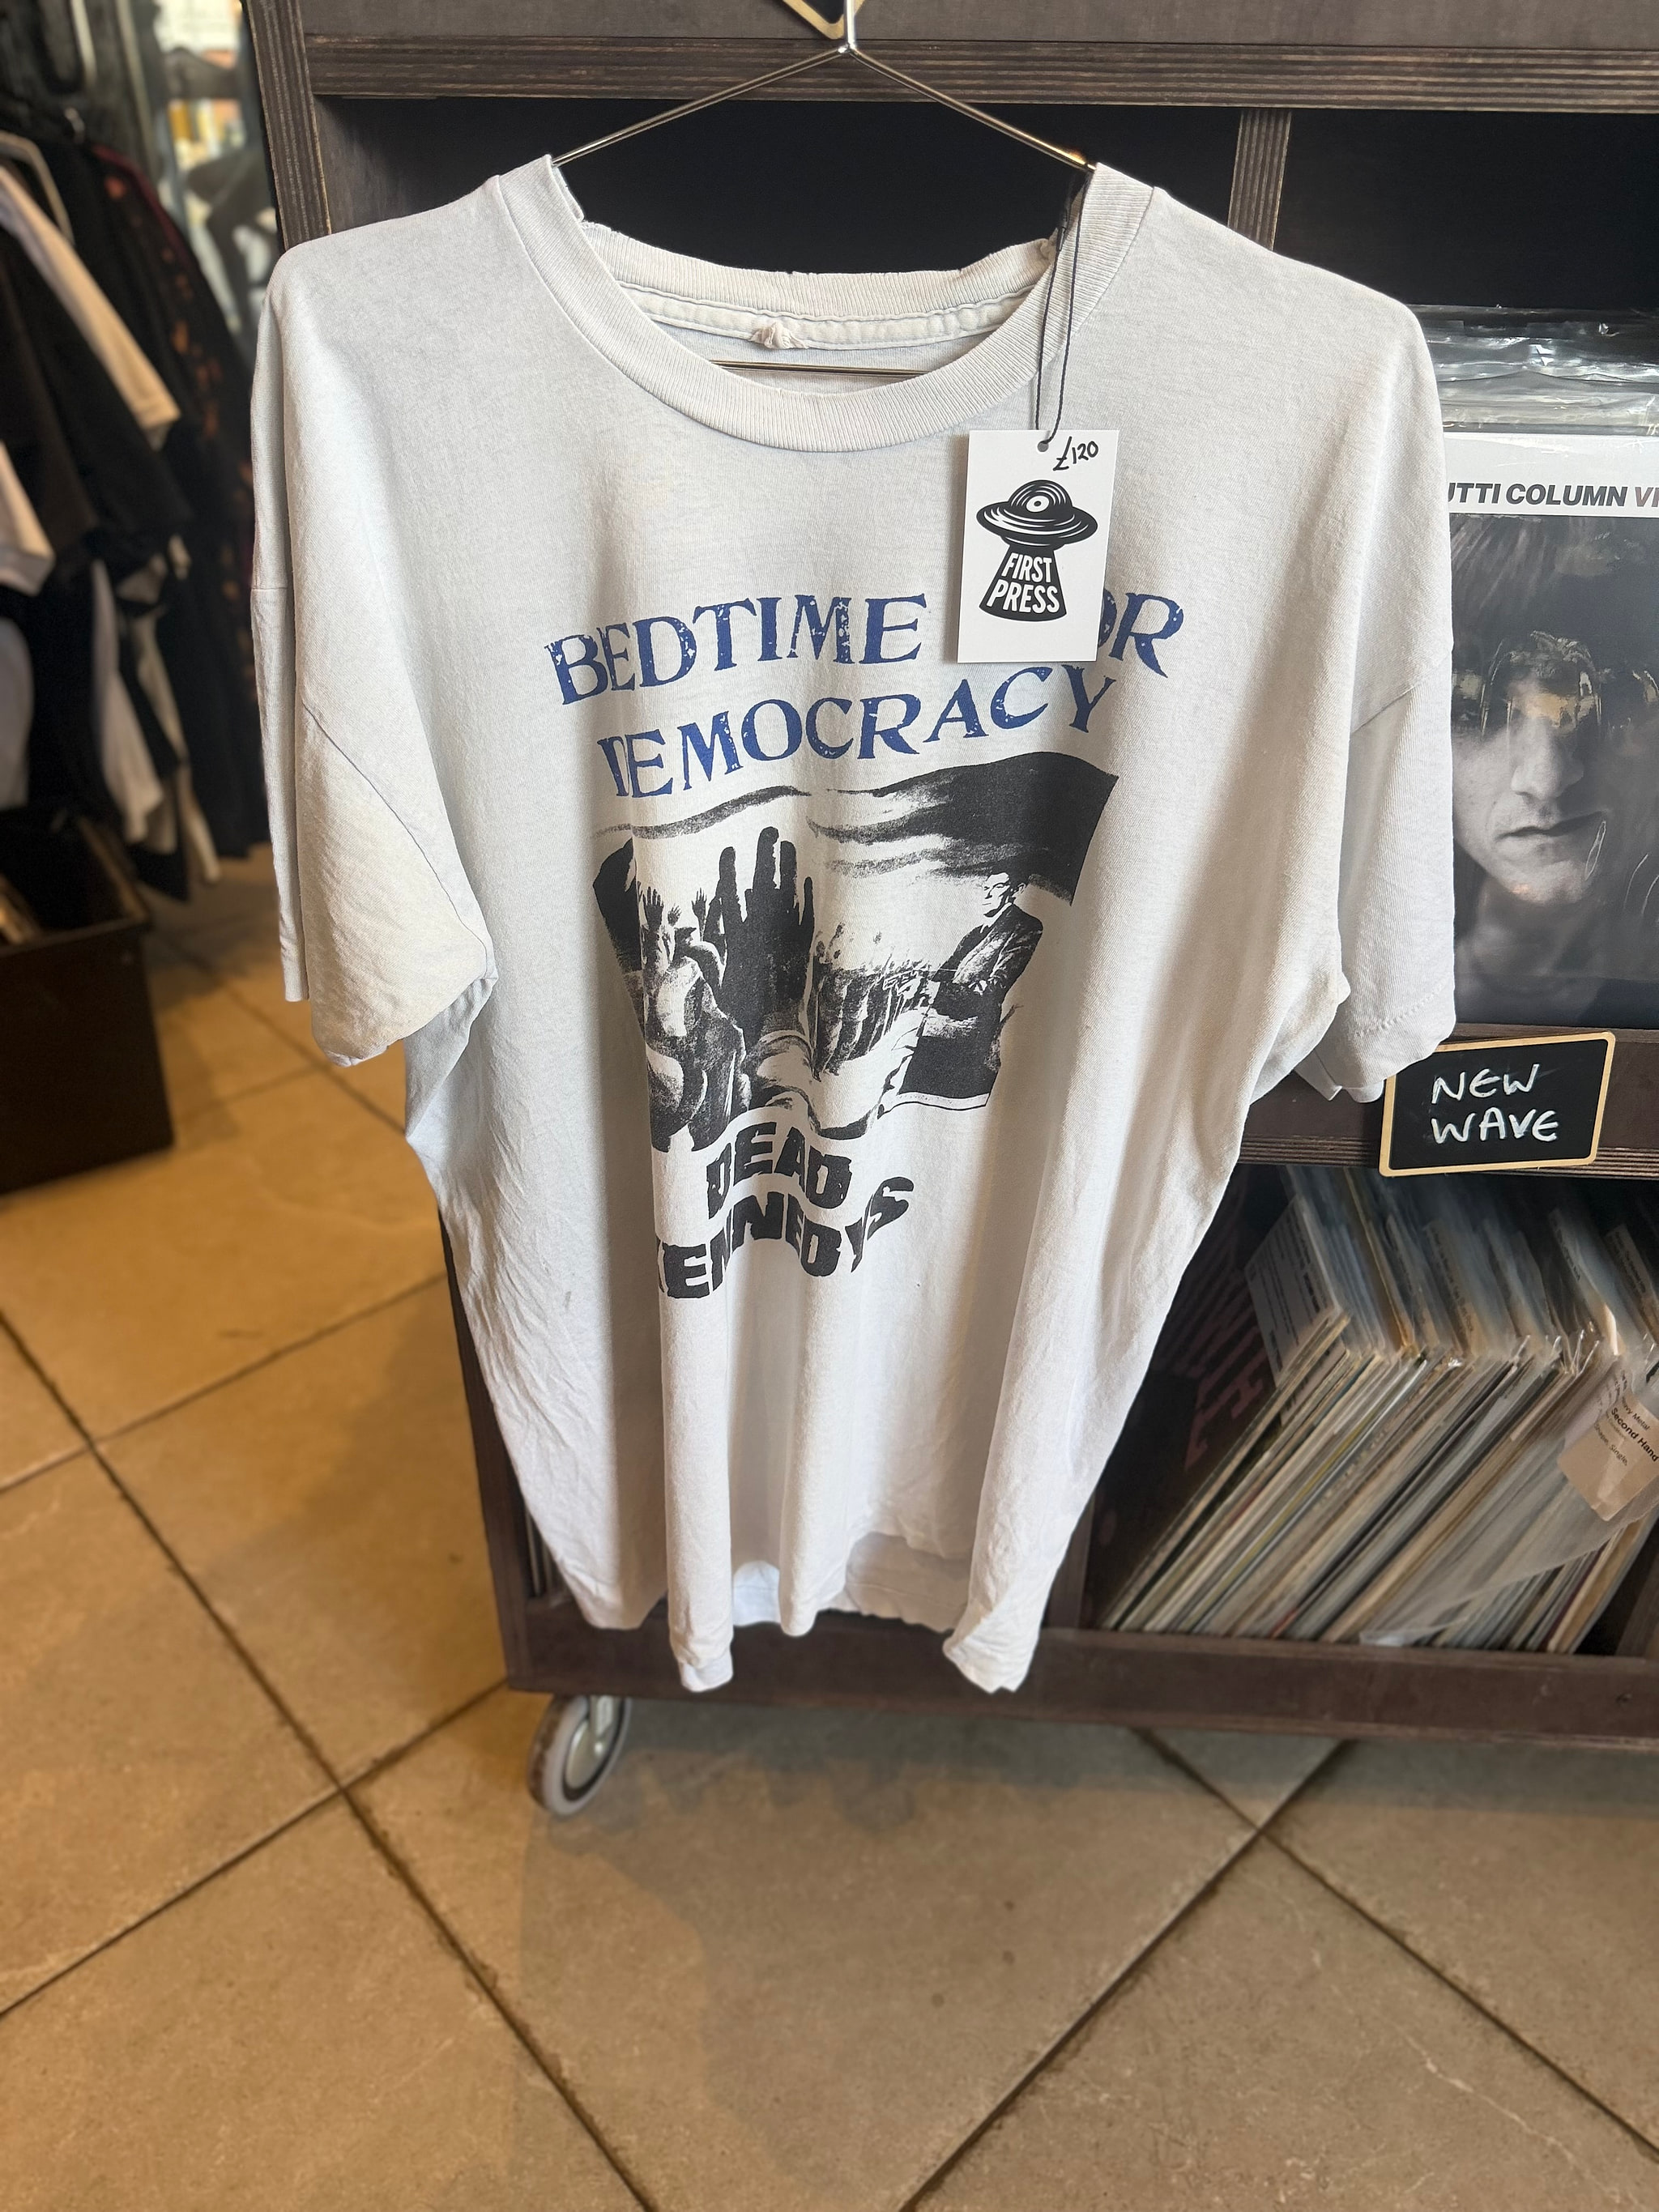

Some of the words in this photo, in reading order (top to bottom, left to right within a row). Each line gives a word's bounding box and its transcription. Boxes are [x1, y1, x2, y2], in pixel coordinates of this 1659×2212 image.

[1052, 436, 1099, 471] £120
[1505, 484, 1628, 507] COLUMN
[1001, 552, 1052, 583] FIRST
[986, 579, 1060, 615] PRESS
[545, 592, 928, 705] BEDTIME
[1431, 1063, 1540, 1104] NEW
[1431, 1106, 1559, 1144] WAVE
[706, 1122, 852, 1219] DEAD
[1611, 1407, 1639, 1439] Second
[1637, 1438, 1659, 1462] Hand
